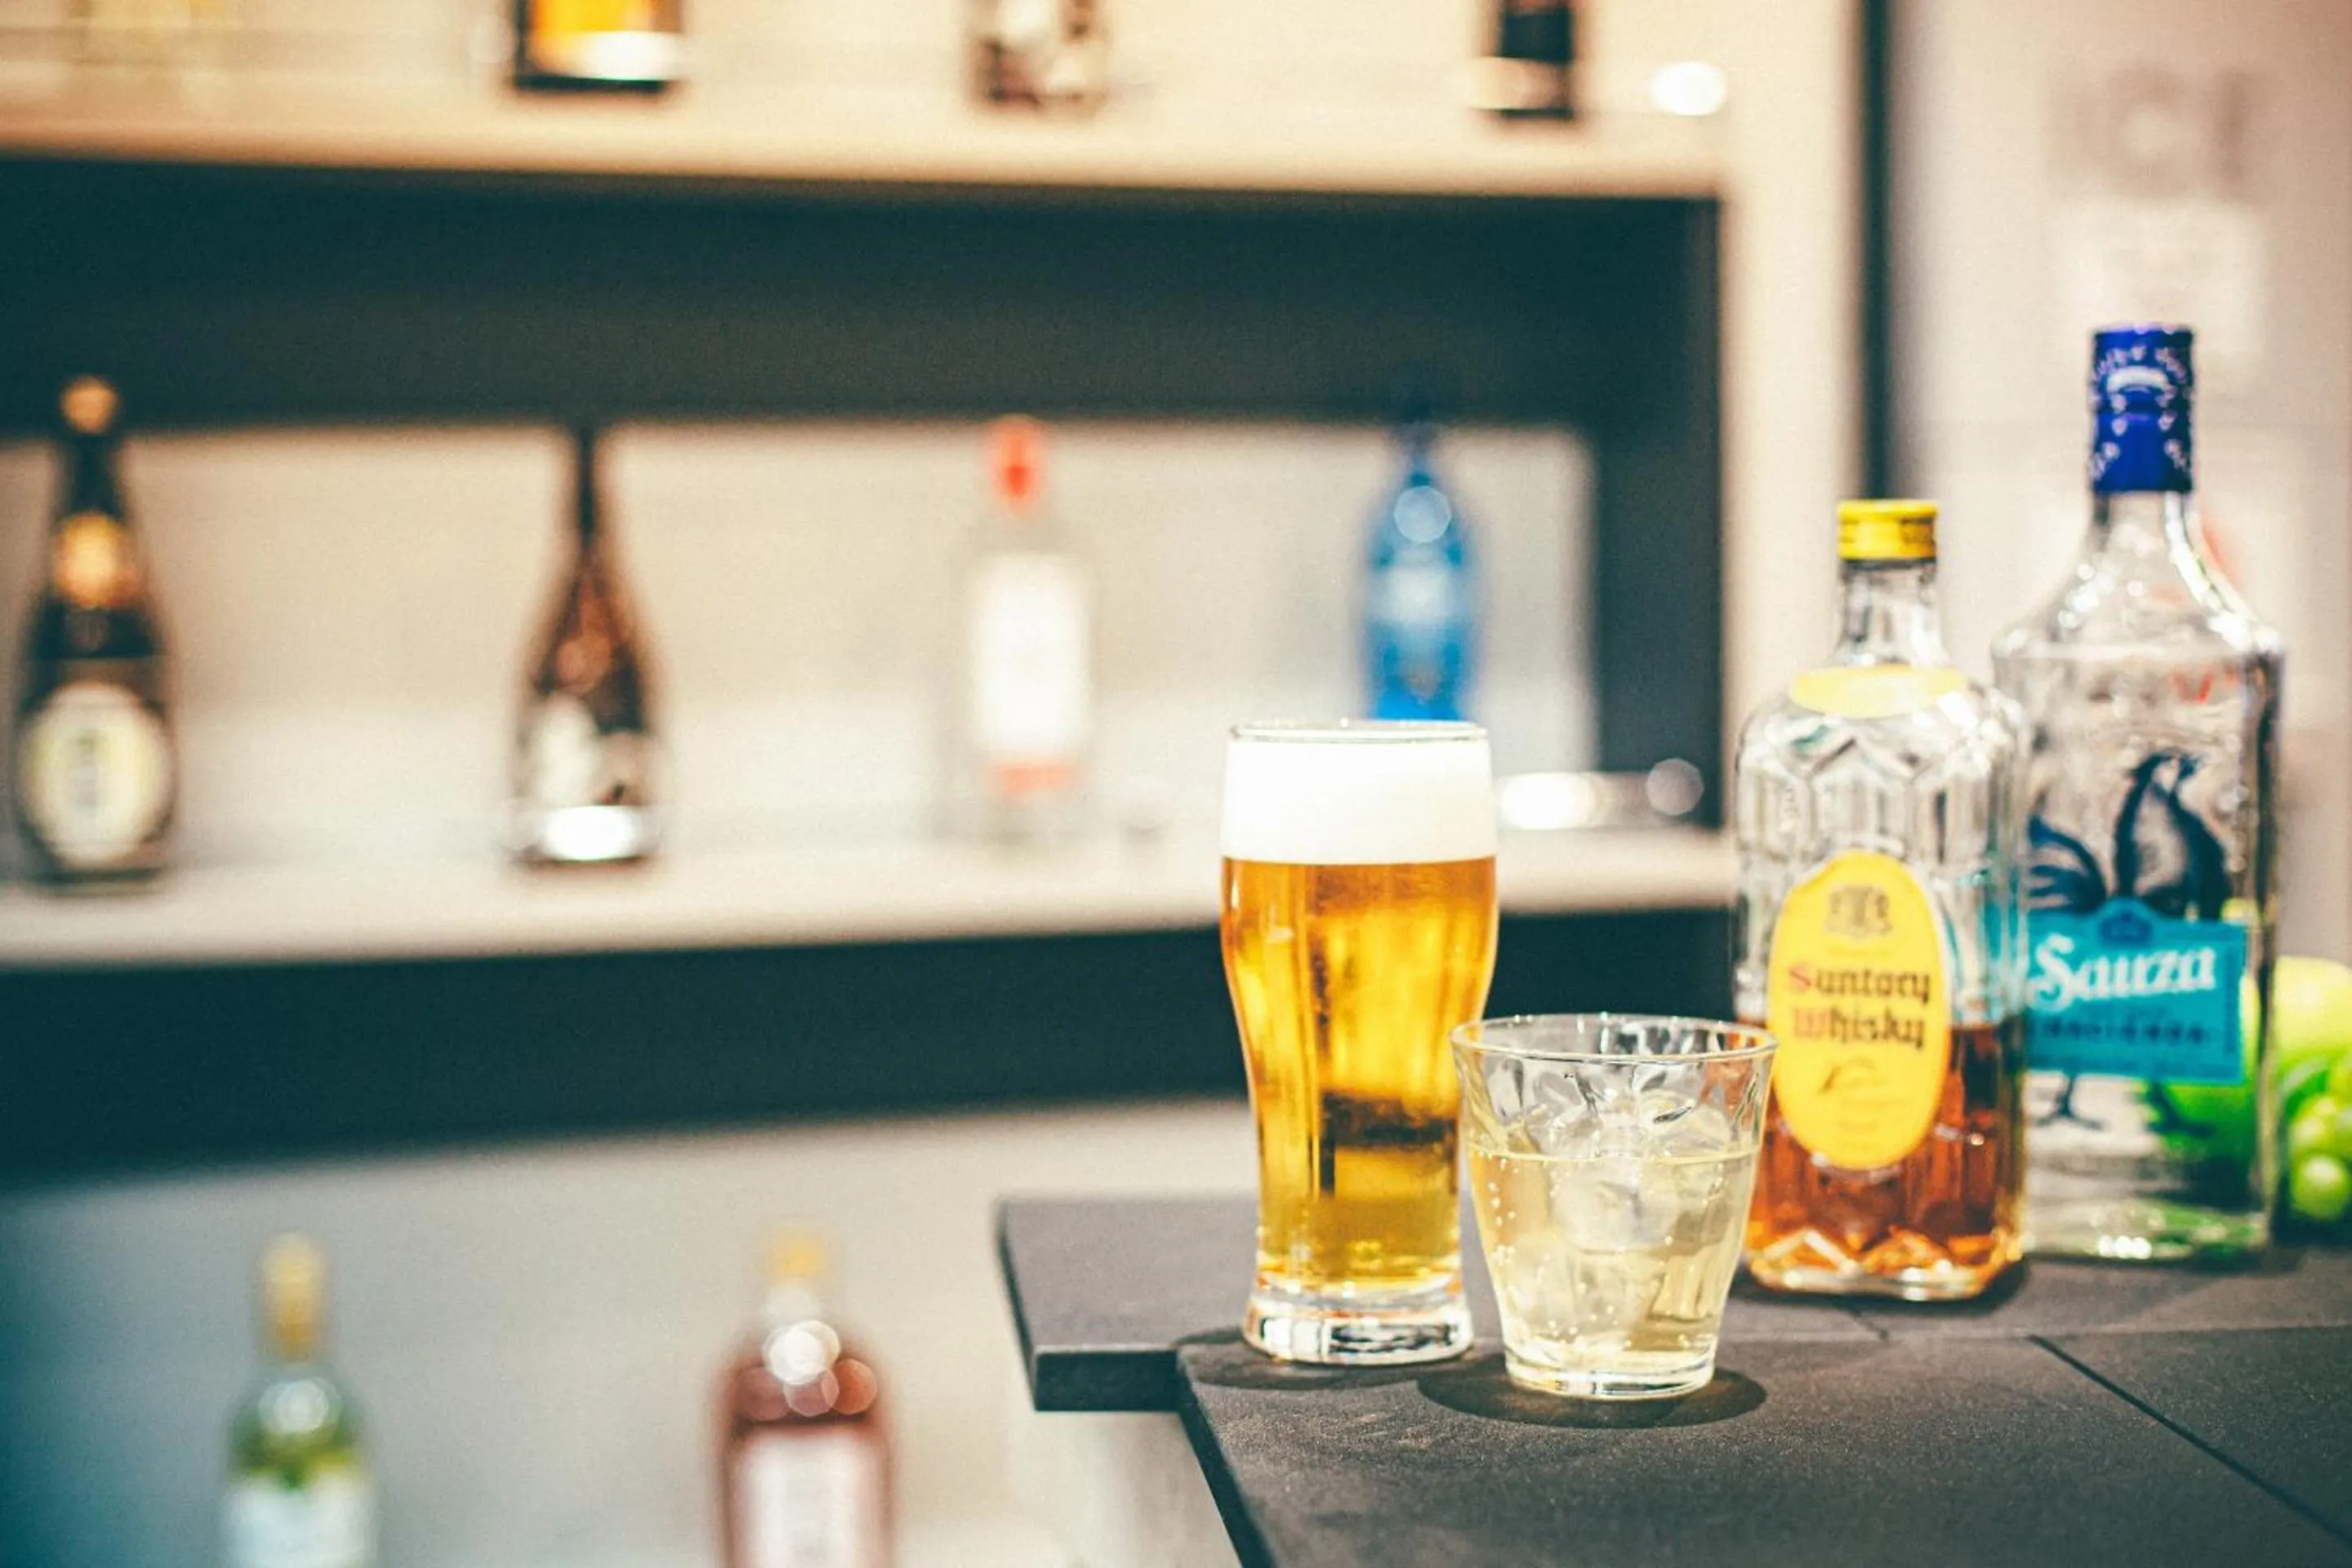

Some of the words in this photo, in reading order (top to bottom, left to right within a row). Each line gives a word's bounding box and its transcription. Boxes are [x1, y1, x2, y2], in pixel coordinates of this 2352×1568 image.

[1788, 963, 1931, 1004] Suntory
[2027, 933, 2216, 1011] Sauza
[1794, 1006, 1925, 1050] Whisky
